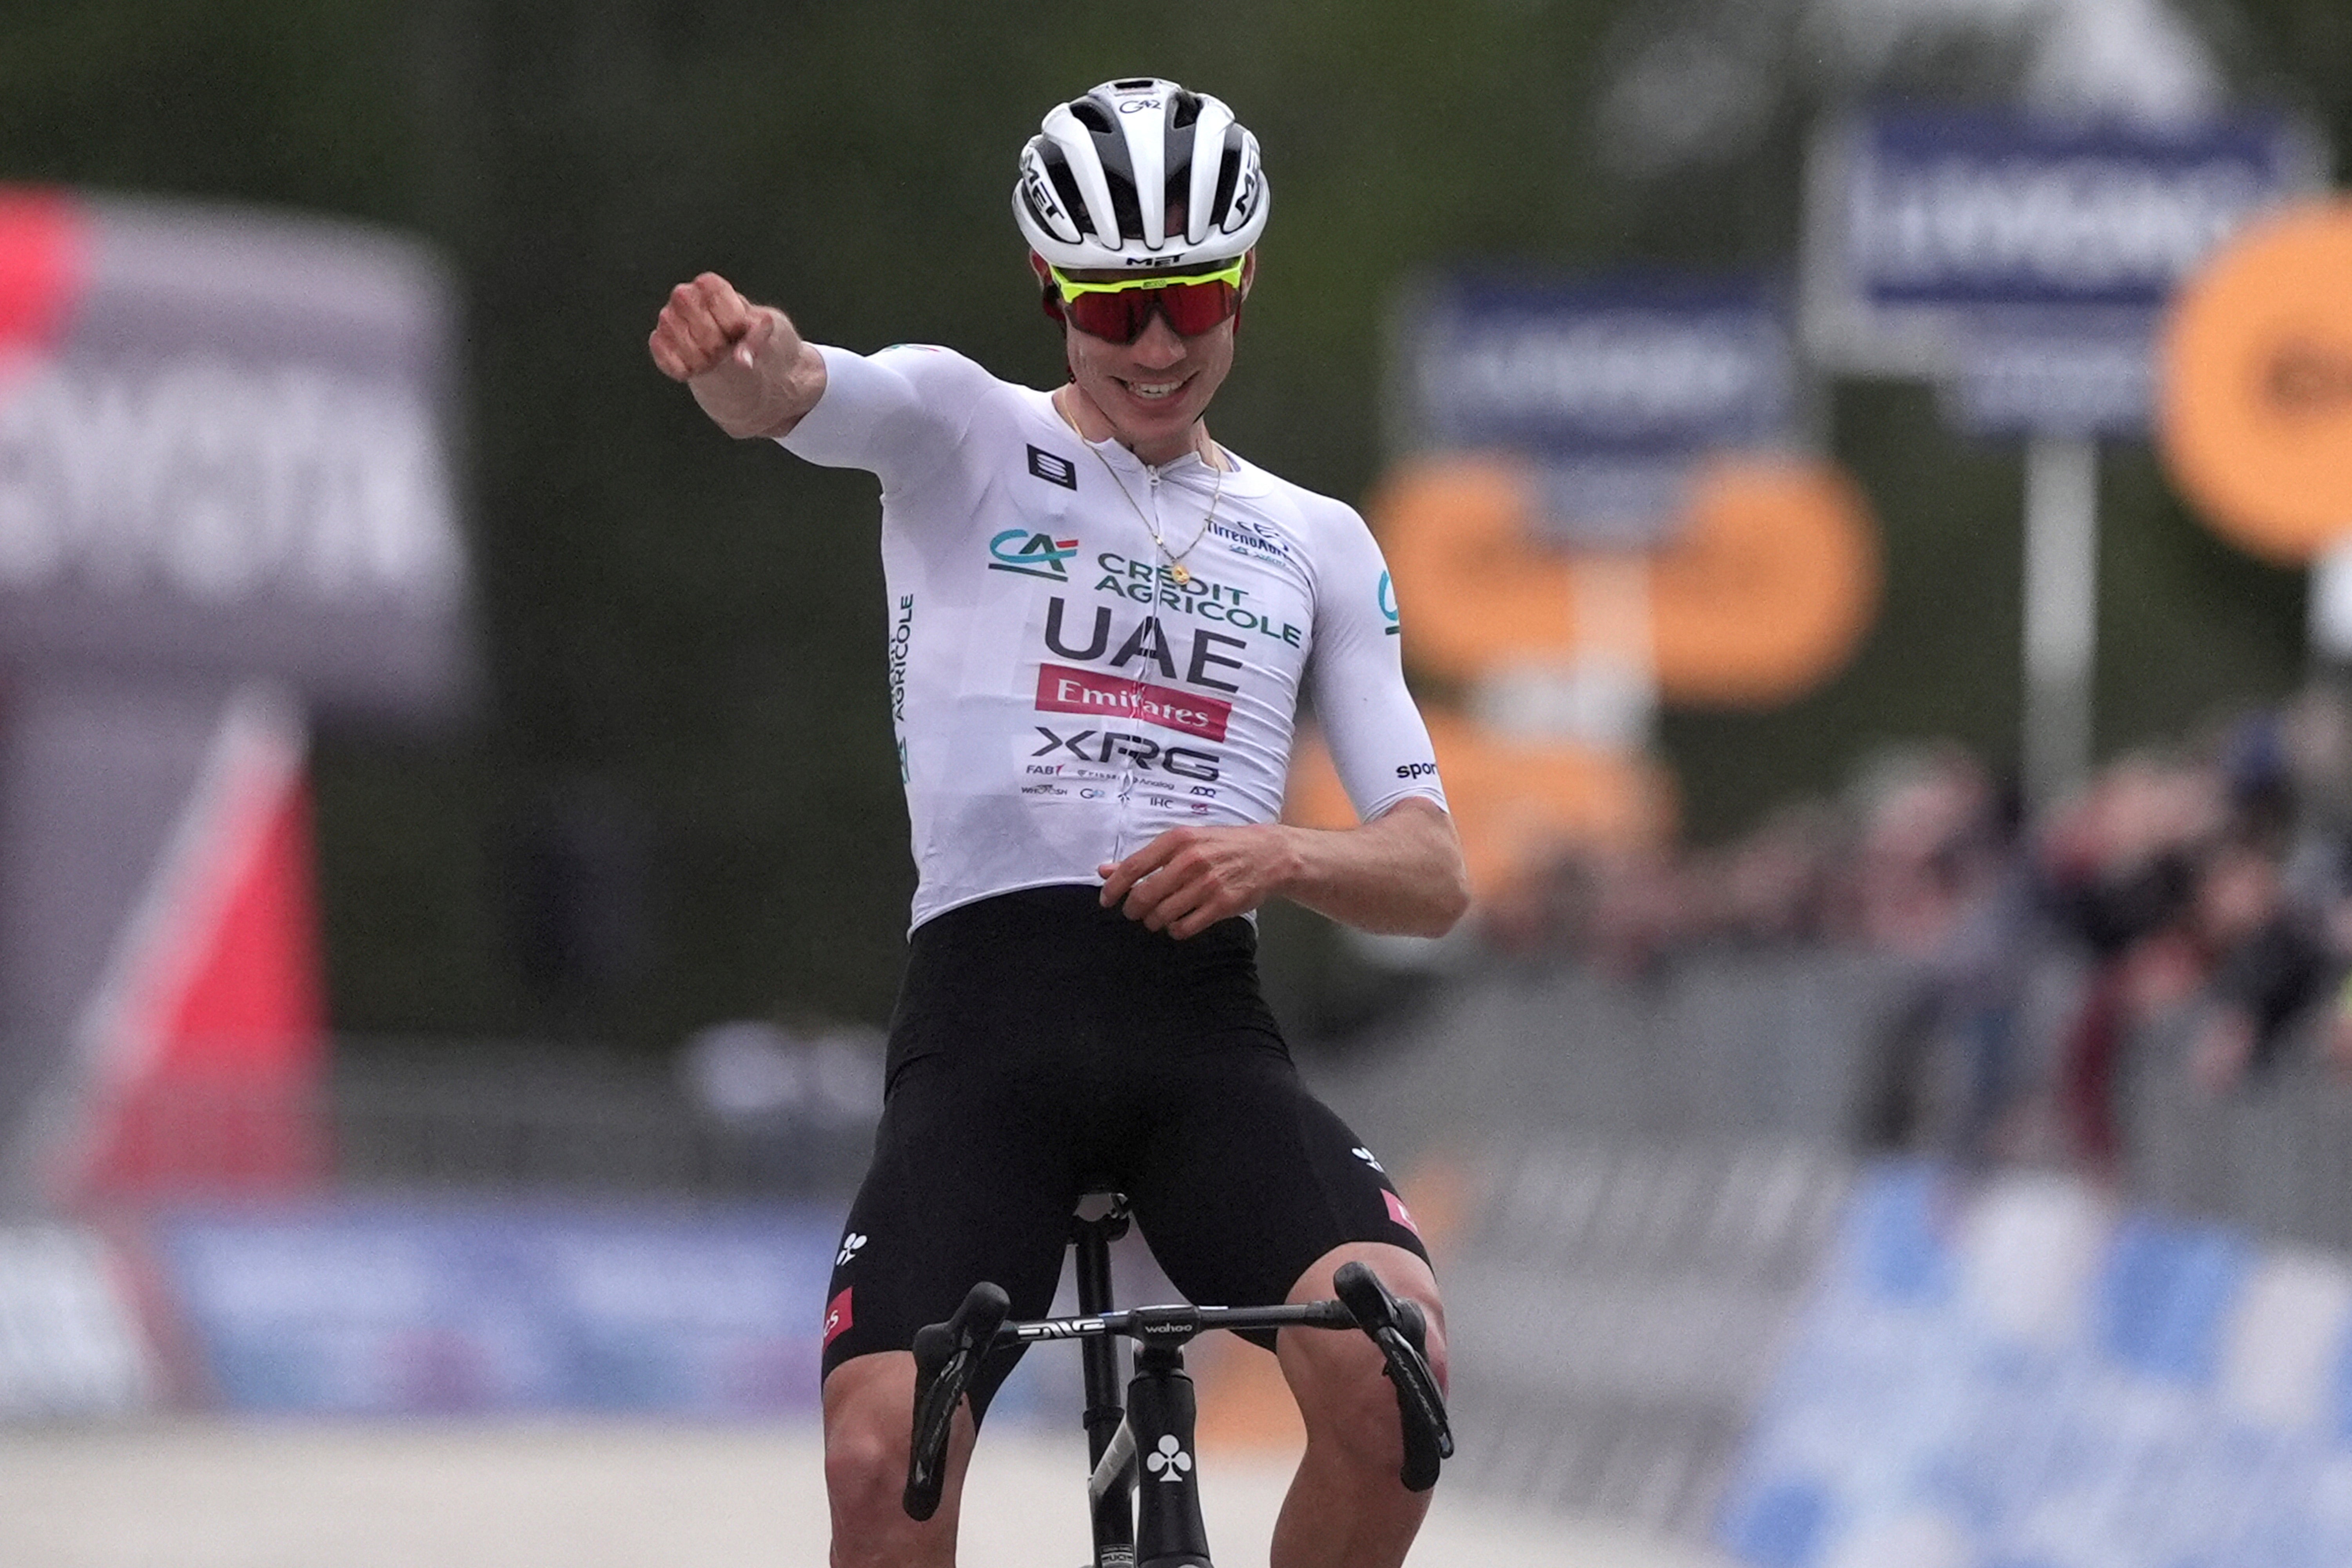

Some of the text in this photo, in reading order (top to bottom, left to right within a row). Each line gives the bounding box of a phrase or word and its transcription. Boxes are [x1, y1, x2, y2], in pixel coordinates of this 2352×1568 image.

[1127, 253, 1185, 267] MET
[1094, 575, 1301, 649] AGRICOLE
[1045, 597, 1247, 693] UAE
[1058, 679, 1209, 728] Emirates
[1031, 726, 1220, 781] XRG
[1150, 797, 1173, 809] IHC
[1145, 1324, 1192, 1334] wahoo
